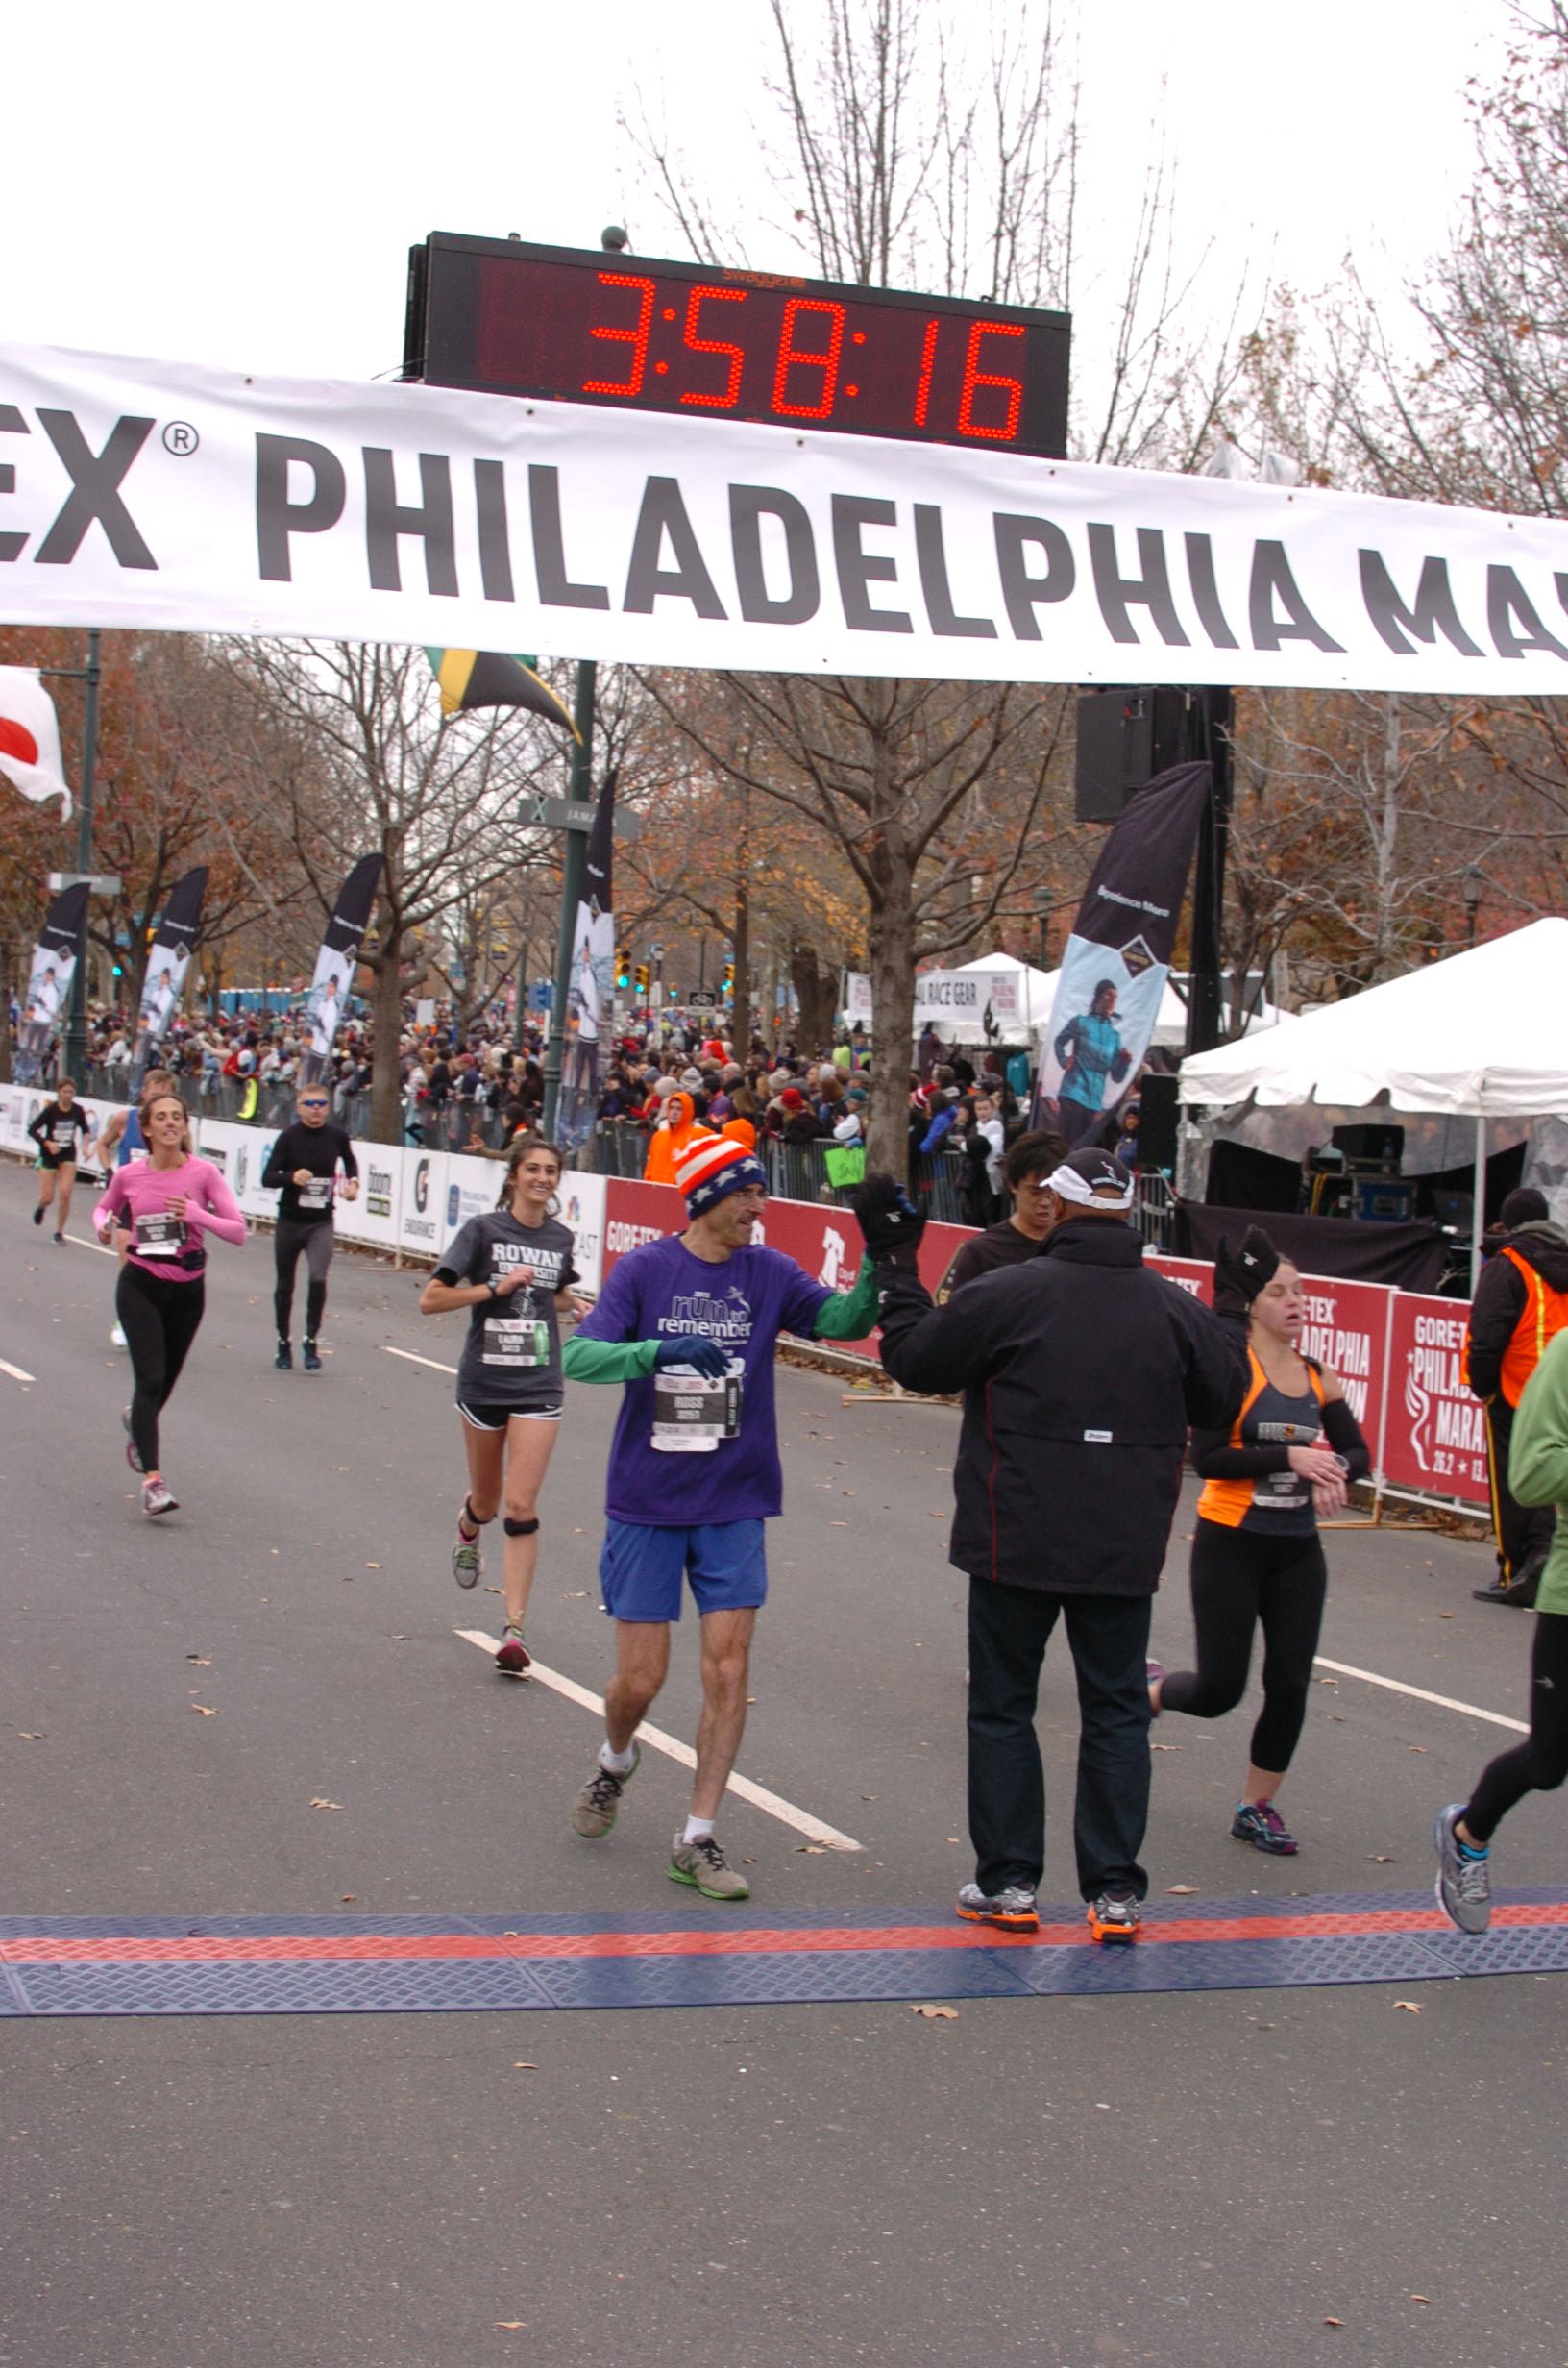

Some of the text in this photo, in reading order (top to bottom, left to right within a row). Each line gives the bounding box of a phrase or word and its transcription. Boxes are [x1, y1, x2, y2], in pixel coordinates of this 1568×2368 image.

[581, 272, 1027, 441] 3:58:16
[255, 431, 1349, 654] PHILADELPHIA
[1357, 548, 1568, 662] MA
[928, 982, 951, 1006] RACE
[954, 982, 978, 1007] GEAR
[491, 1243, 564, 1270] ROWAN
[672, 1295, 729, 1322] run
[657, 1317, 753, 1338] remember
[1414, 1315, 1468, 1350] GORE-T
[1433, 1450, 1455, 1476] 26.2
